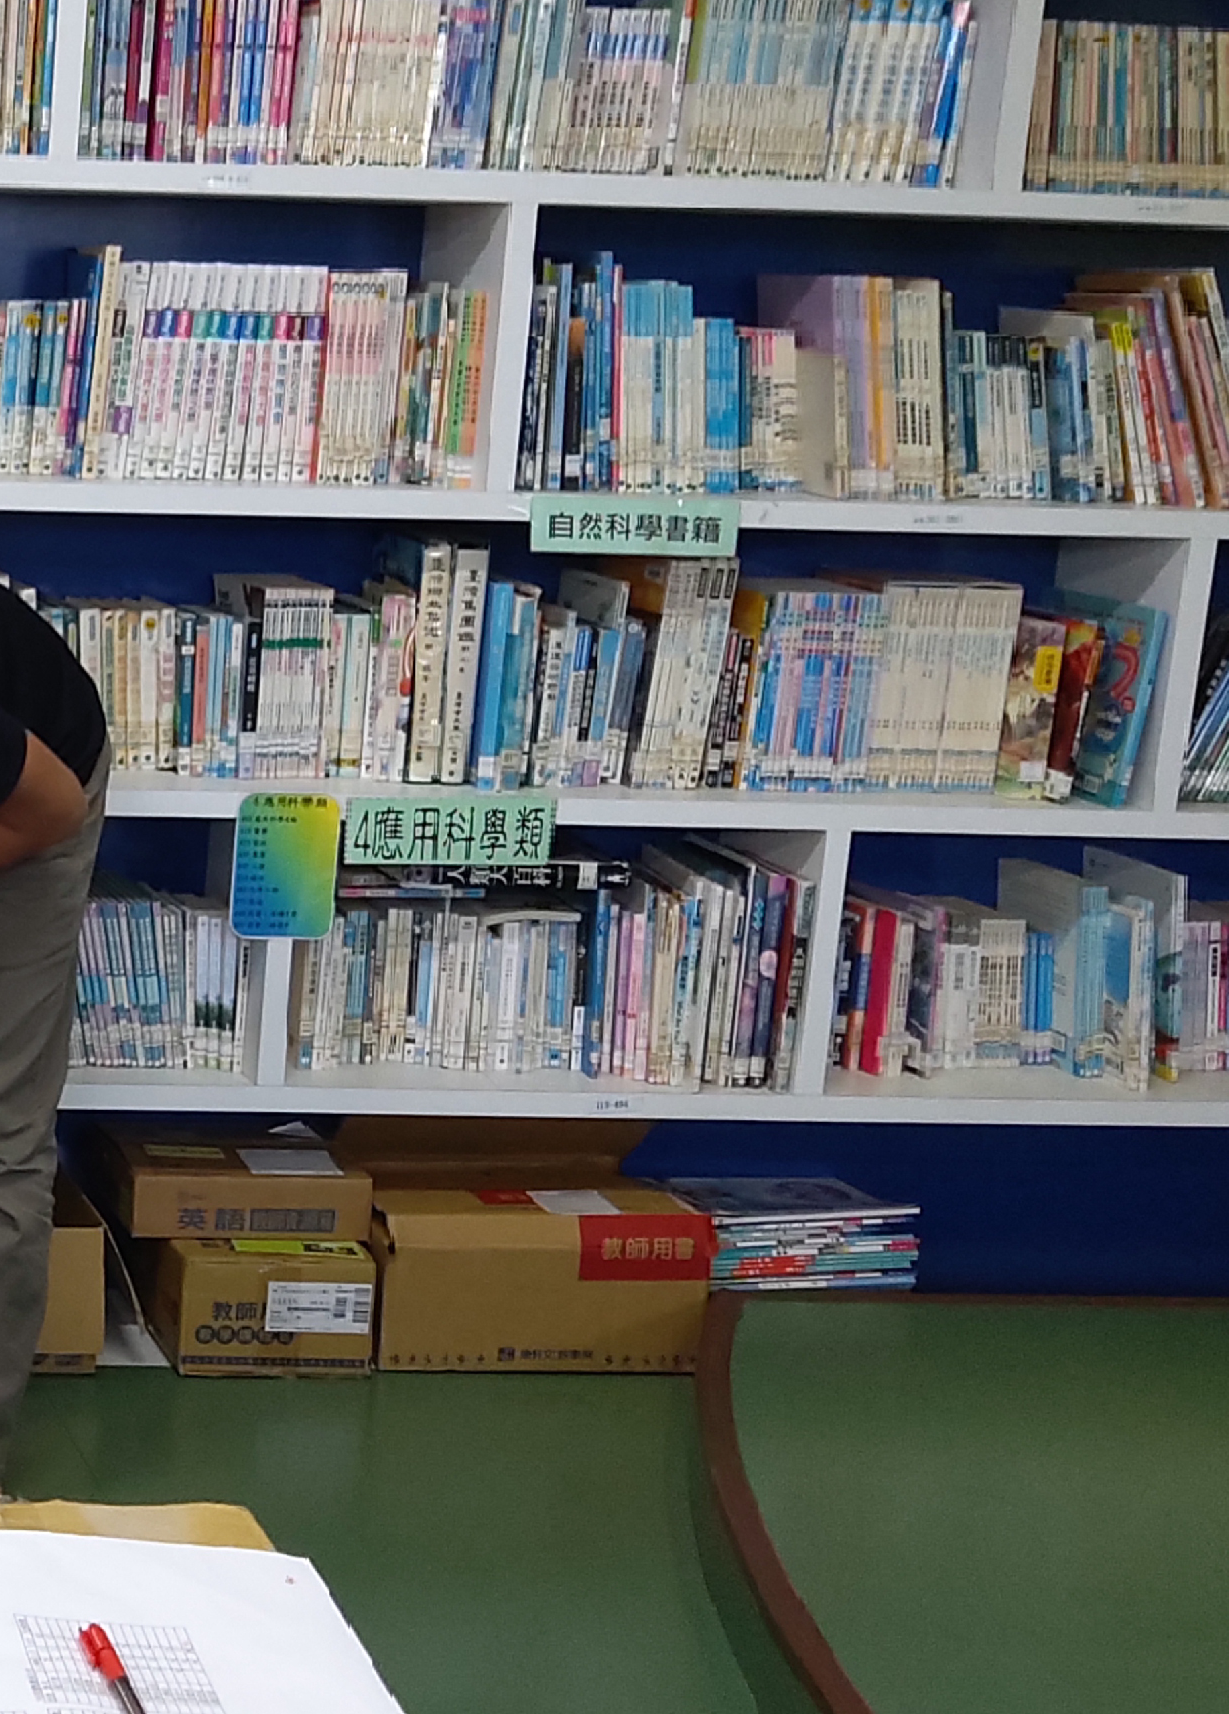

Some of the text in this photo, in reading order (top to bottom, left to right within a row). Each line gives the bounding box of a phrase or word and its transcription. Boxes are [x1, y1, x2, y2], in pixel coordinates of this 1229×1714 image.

[548, 511, 722, 544] 自然科學書籍
[353, 806, 546, 860] 4應用科學類
[177, 1208, 246, 1232] 英語
[600, 1237, 695, 1260] 教師用書
[211, 1301, 268, 1322] 教師
